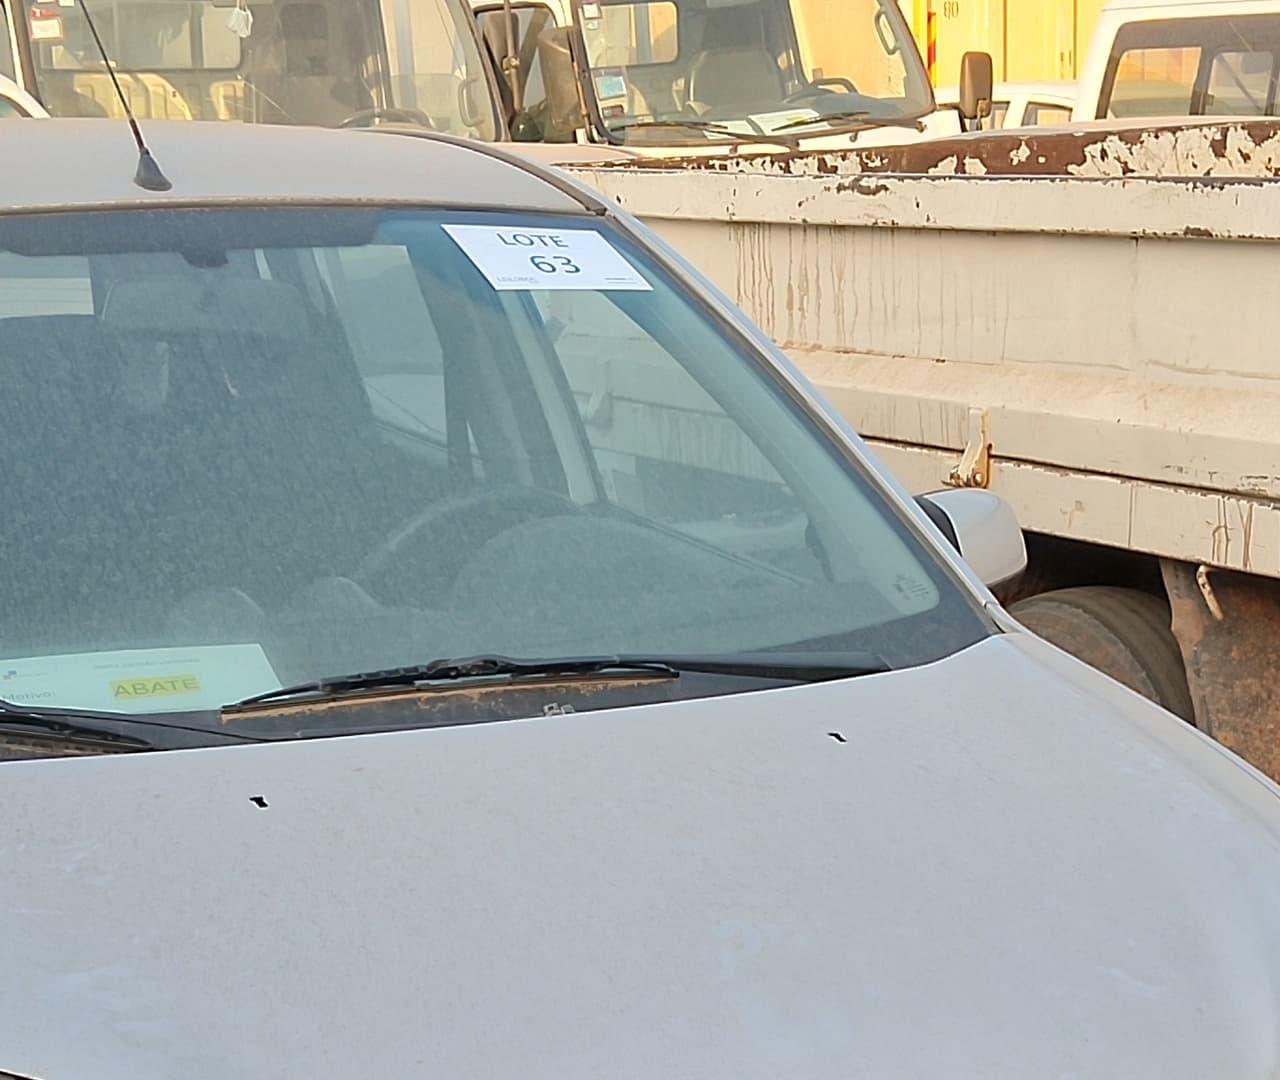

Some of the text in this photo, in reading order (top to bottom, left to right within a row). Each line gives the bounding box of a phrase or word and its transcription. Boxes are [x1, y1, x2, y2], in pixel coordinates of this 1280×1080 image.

[496, 232, 569, 248] LOTE
[530, 255, 581, 274] 63
[114, 678, 200, 697] ABATE
